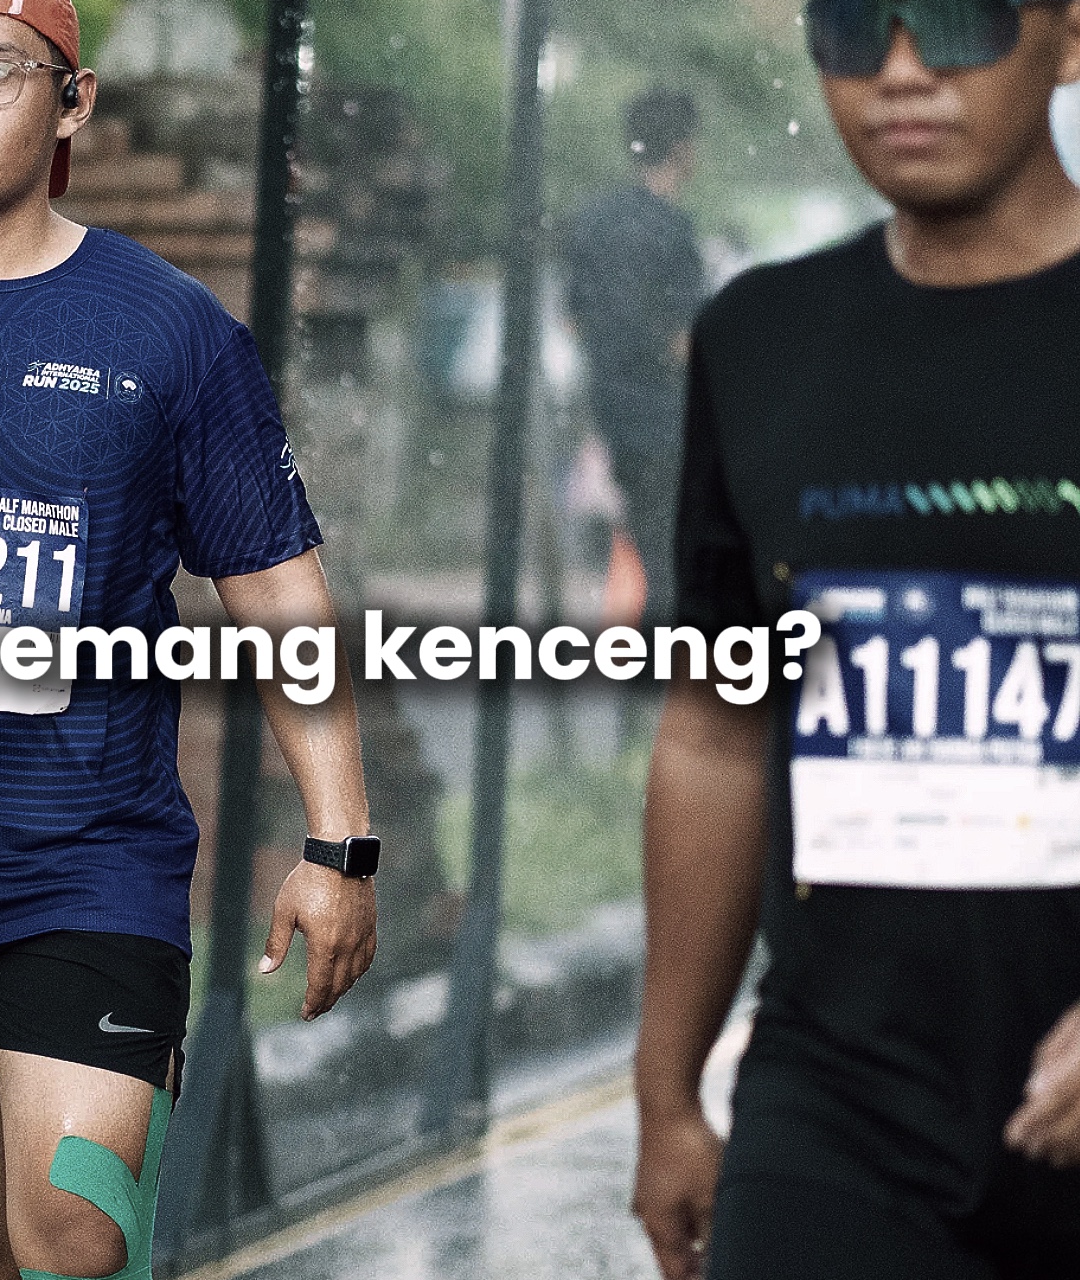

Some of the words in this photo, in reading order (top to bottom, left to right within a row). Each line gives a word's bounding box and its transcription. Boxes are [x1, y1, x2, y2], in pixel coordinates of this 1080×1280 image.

[43, 362, 101, 378] ADHYAKSA
[22, 374, 58, 389] RUN
[59, 378, 101, 395] 2025
[21, 500, 80, 522] MARATHON
[2, 514, 47, 534] CLOSED
[48, 519, 79, 538] MALE
